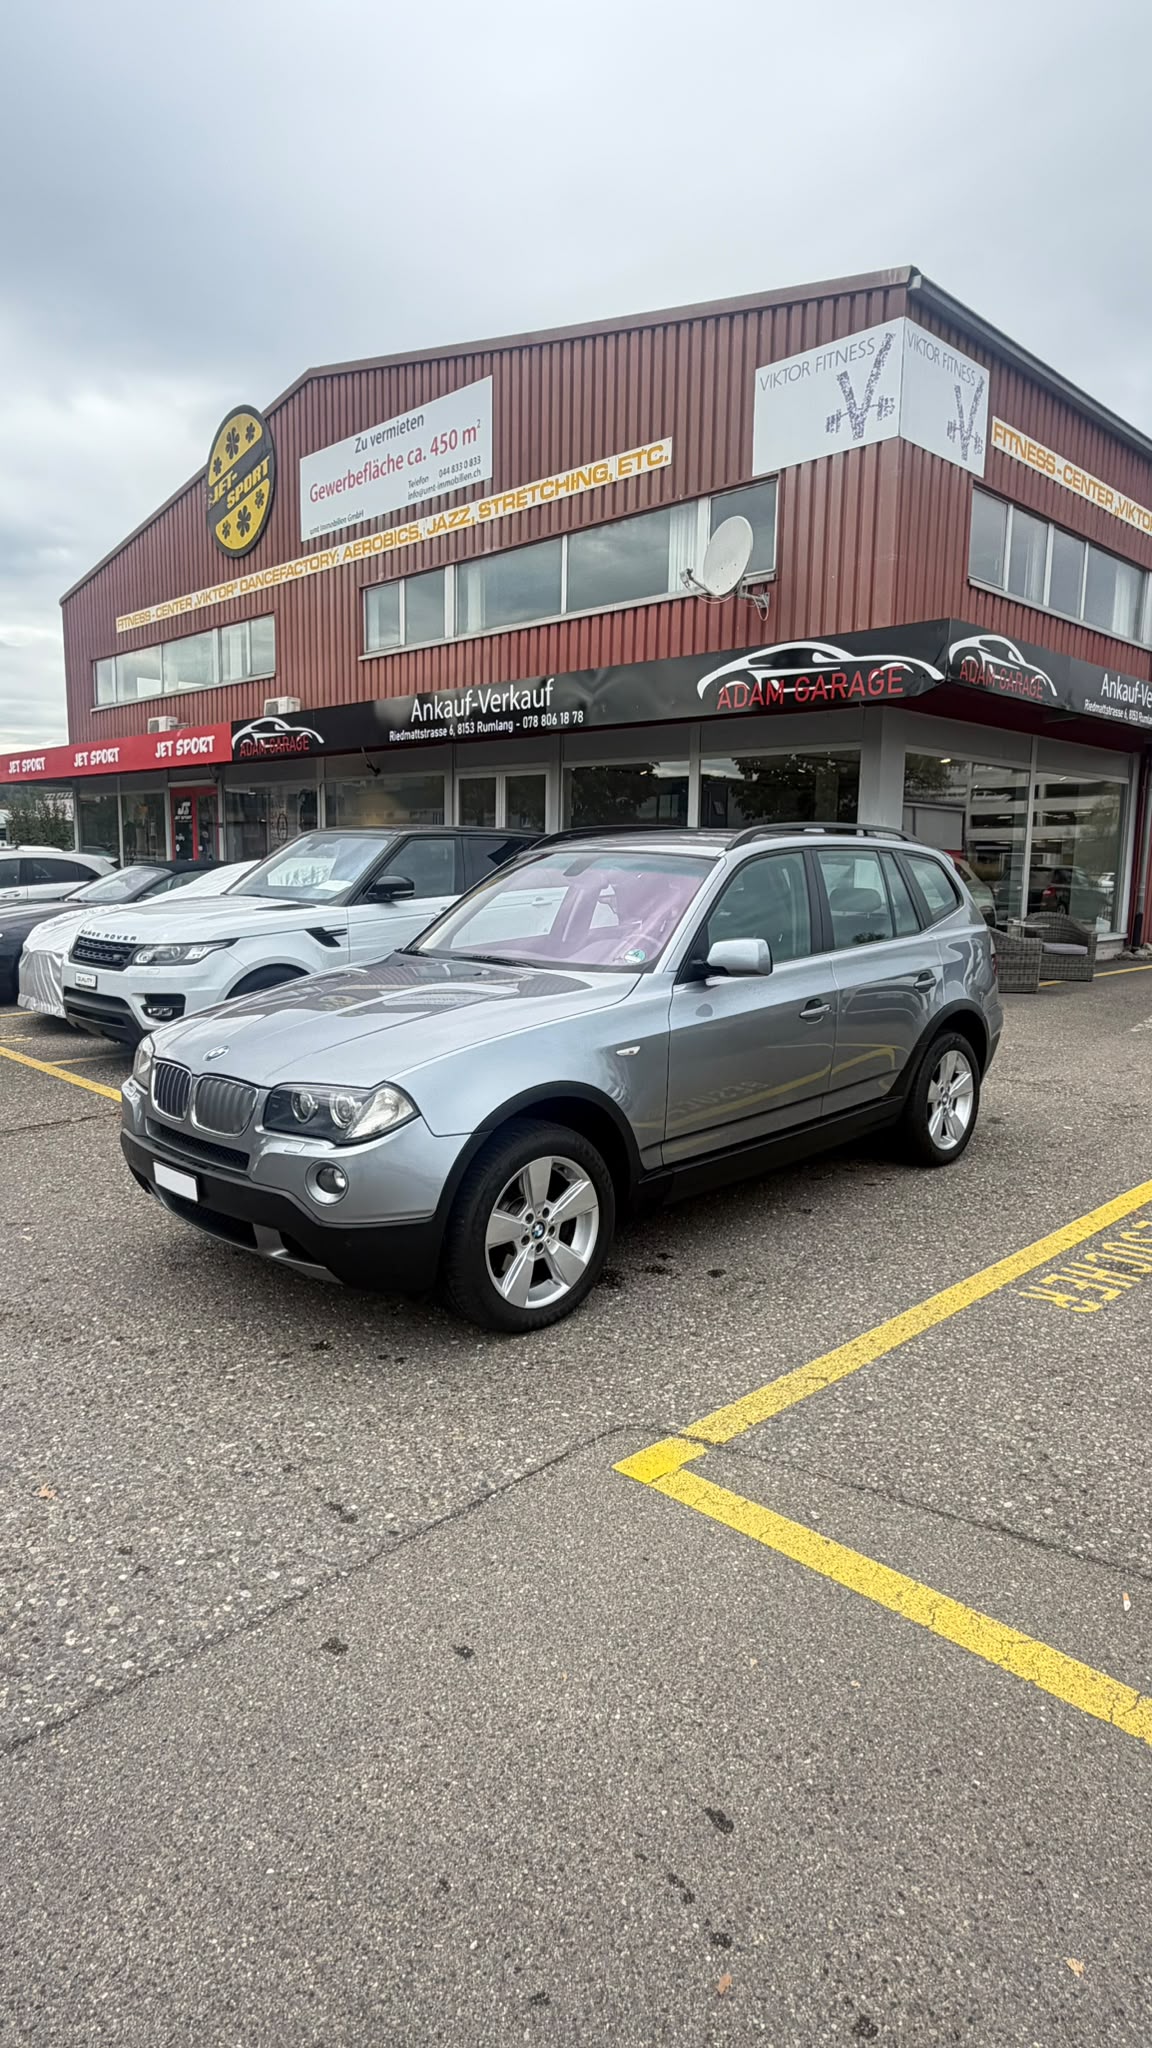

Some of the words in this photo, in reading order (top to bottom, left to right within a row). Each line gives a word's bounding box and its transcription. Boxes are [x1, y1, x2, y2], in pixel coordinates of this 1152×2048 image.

[760, 361, 811, 392] VIKTOR
[815, 337, 875, 373] FITNESS
[907, 329, 940, 365] VIKTOR
[942, 352, 976, 387] FITNESS
[354, 437, 368, 453] Zu
[370, 413, 425, 450] vermieten
[227, 456, 270, 510] SPORT
[309, 453, 404, 503] Gewerbefläche
[407, 447, 427, 466] ca.
[430, 428, 458, 457] 450
[407, 475, 429, 489] Telefon
[438, 466, 450, 478] 044
[451, 462, 463, 474] 833
[469, 455, 482, 467] 833
[342, 525, 423, 561] AEROBICS,
[426, 504, 476, 535] JAZZ,
[478, 462, 613, 520] STRETCHING,
[617, 443, 670, 477] ETC.
[716, 679, 784, 711] ADAM
[794, 664, 905, 702] GARAGE
[959, 659, 995, 688] ADAM
[999, 668, 1044, 700] GARAGE
[410, 678, 555, 723] Ankauf-Verkauf
[240, 742, 267, 757] ADAM
[269, 735, 310, 754] GARAGE
[389, 726, 448, 742] Riedmattstrasse
[449, 726, 456, 738] 6,
[457, 721, 475, 735] 8153
[522, 716, 538, 729] 078
[540, 713, 558, 727] 806
[560, 712, 569, 725] 18
[572, 710, 584, 724] 78
[8, 760, 21, 774] JET
[21, 757, 46, 774] SPORT
[73, 752, 88, 768] JET
[89, 747, 120, 766] SPORT
[155, 740, 174, 758] JET
[175, 735, 216, 757] SPORT
[80, 929, 101, 938] RANGE
[104, 933, 137, 941] ROVER
